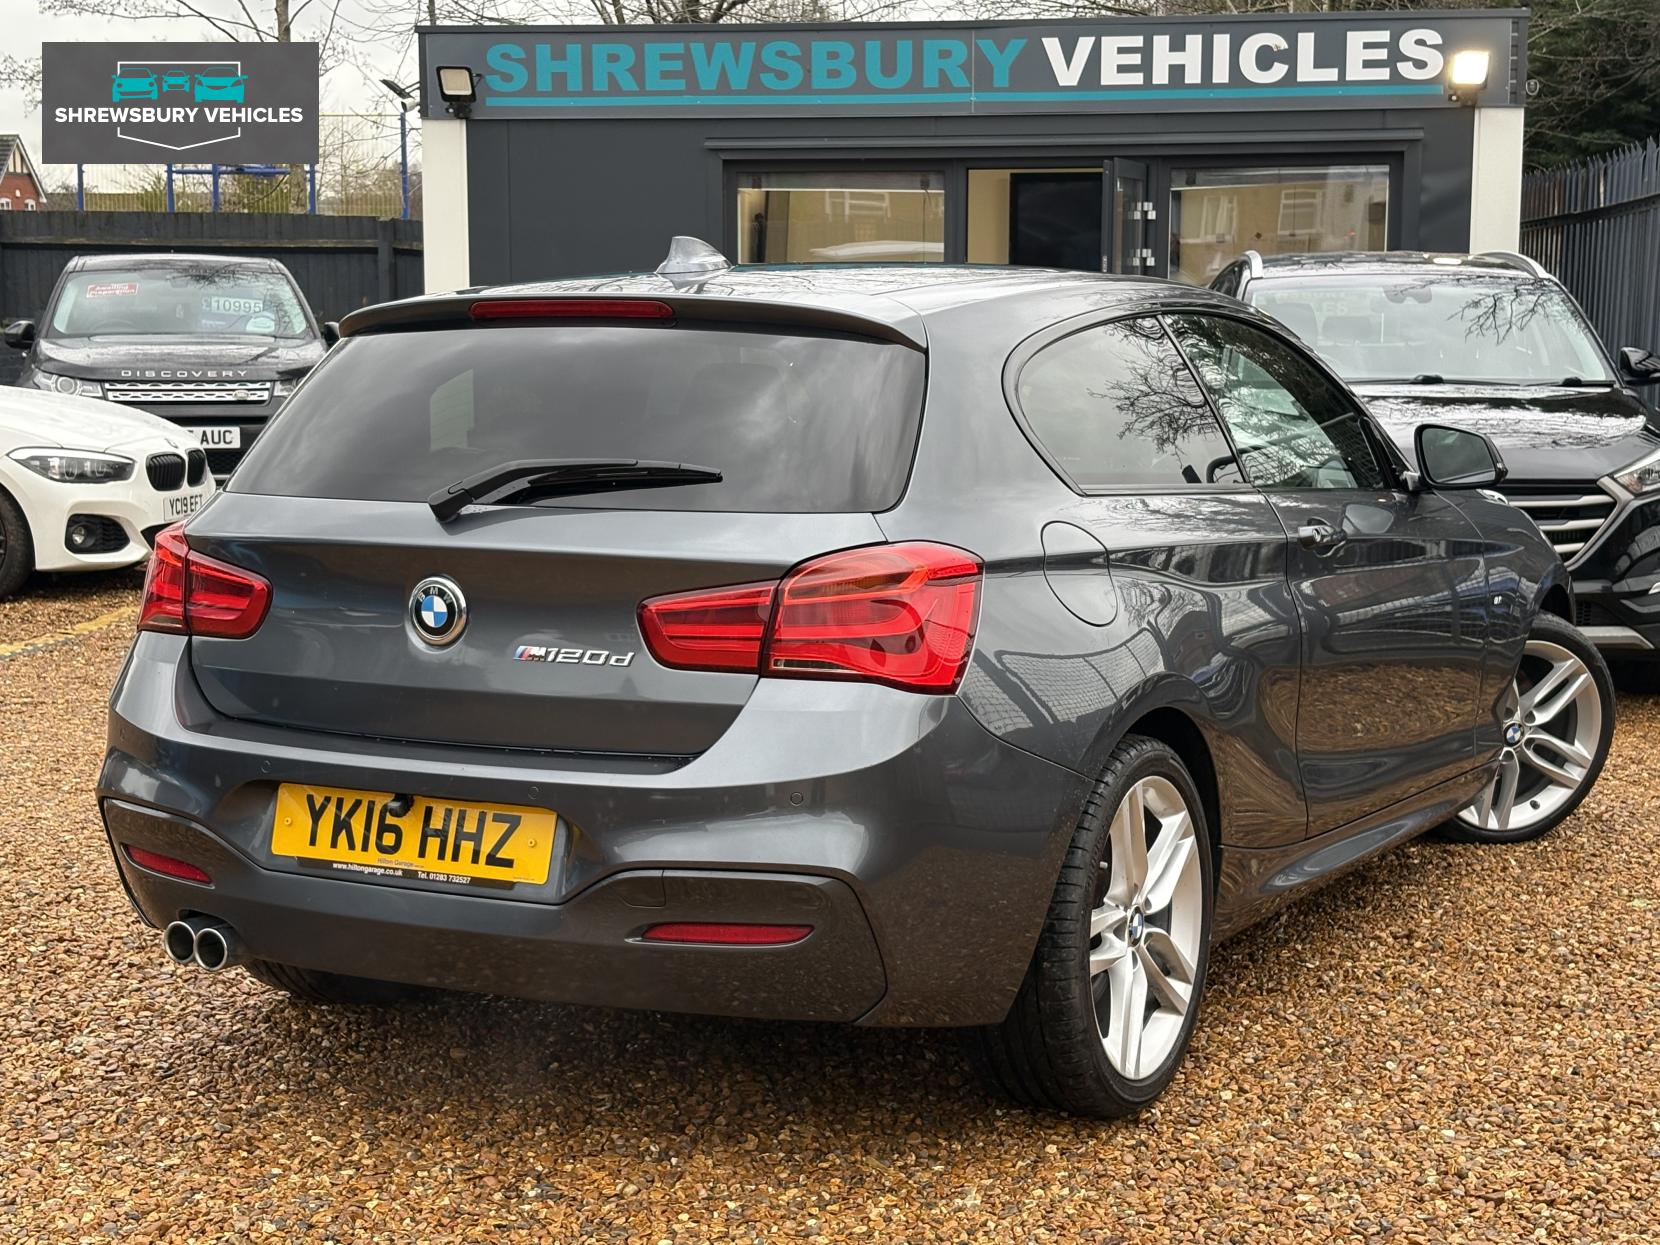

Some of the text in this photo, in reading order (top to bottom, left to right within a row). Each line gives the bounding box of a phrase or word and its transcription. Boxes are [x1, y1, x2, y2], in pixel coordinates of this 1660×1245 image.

[485, 28, 1444, 92] SHREWSBURY VEHICLES
[121, 370, 248, 378] DISCOVERY
[200, 429, 234, 446] AUC
[169, 496, 189, 517] YC19
[417, 586, 453, 605] BMW
[306, 793, 522, 869] YK16 HHZ
